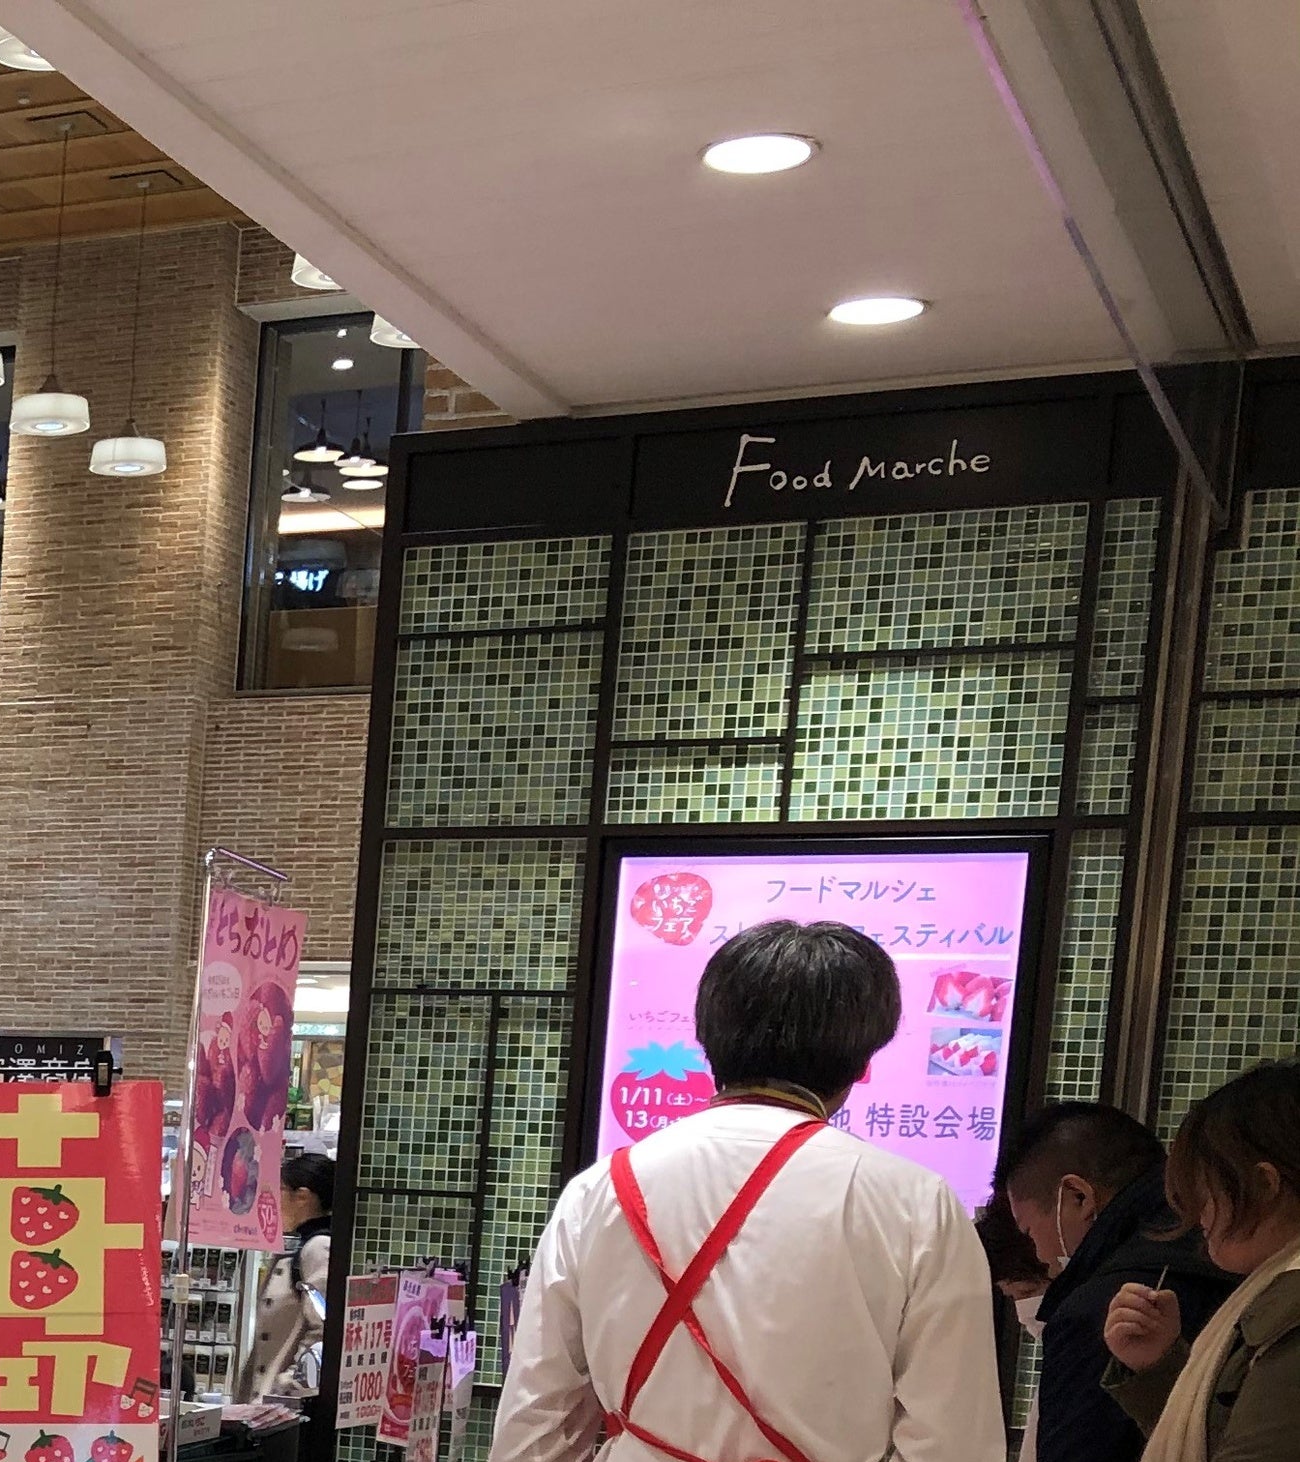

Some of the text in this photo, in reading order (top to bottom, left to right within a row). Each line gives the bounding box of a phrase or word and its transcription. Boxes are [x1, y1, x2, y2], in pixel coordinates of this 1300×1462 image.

[723, 433, 991, 507] Food Marche
[766, 876, 937, 903] フードマルシェ
[629, 1010, 696, 1023] いちごフェ
[865, 1102, 998, 1141] 特設会場
